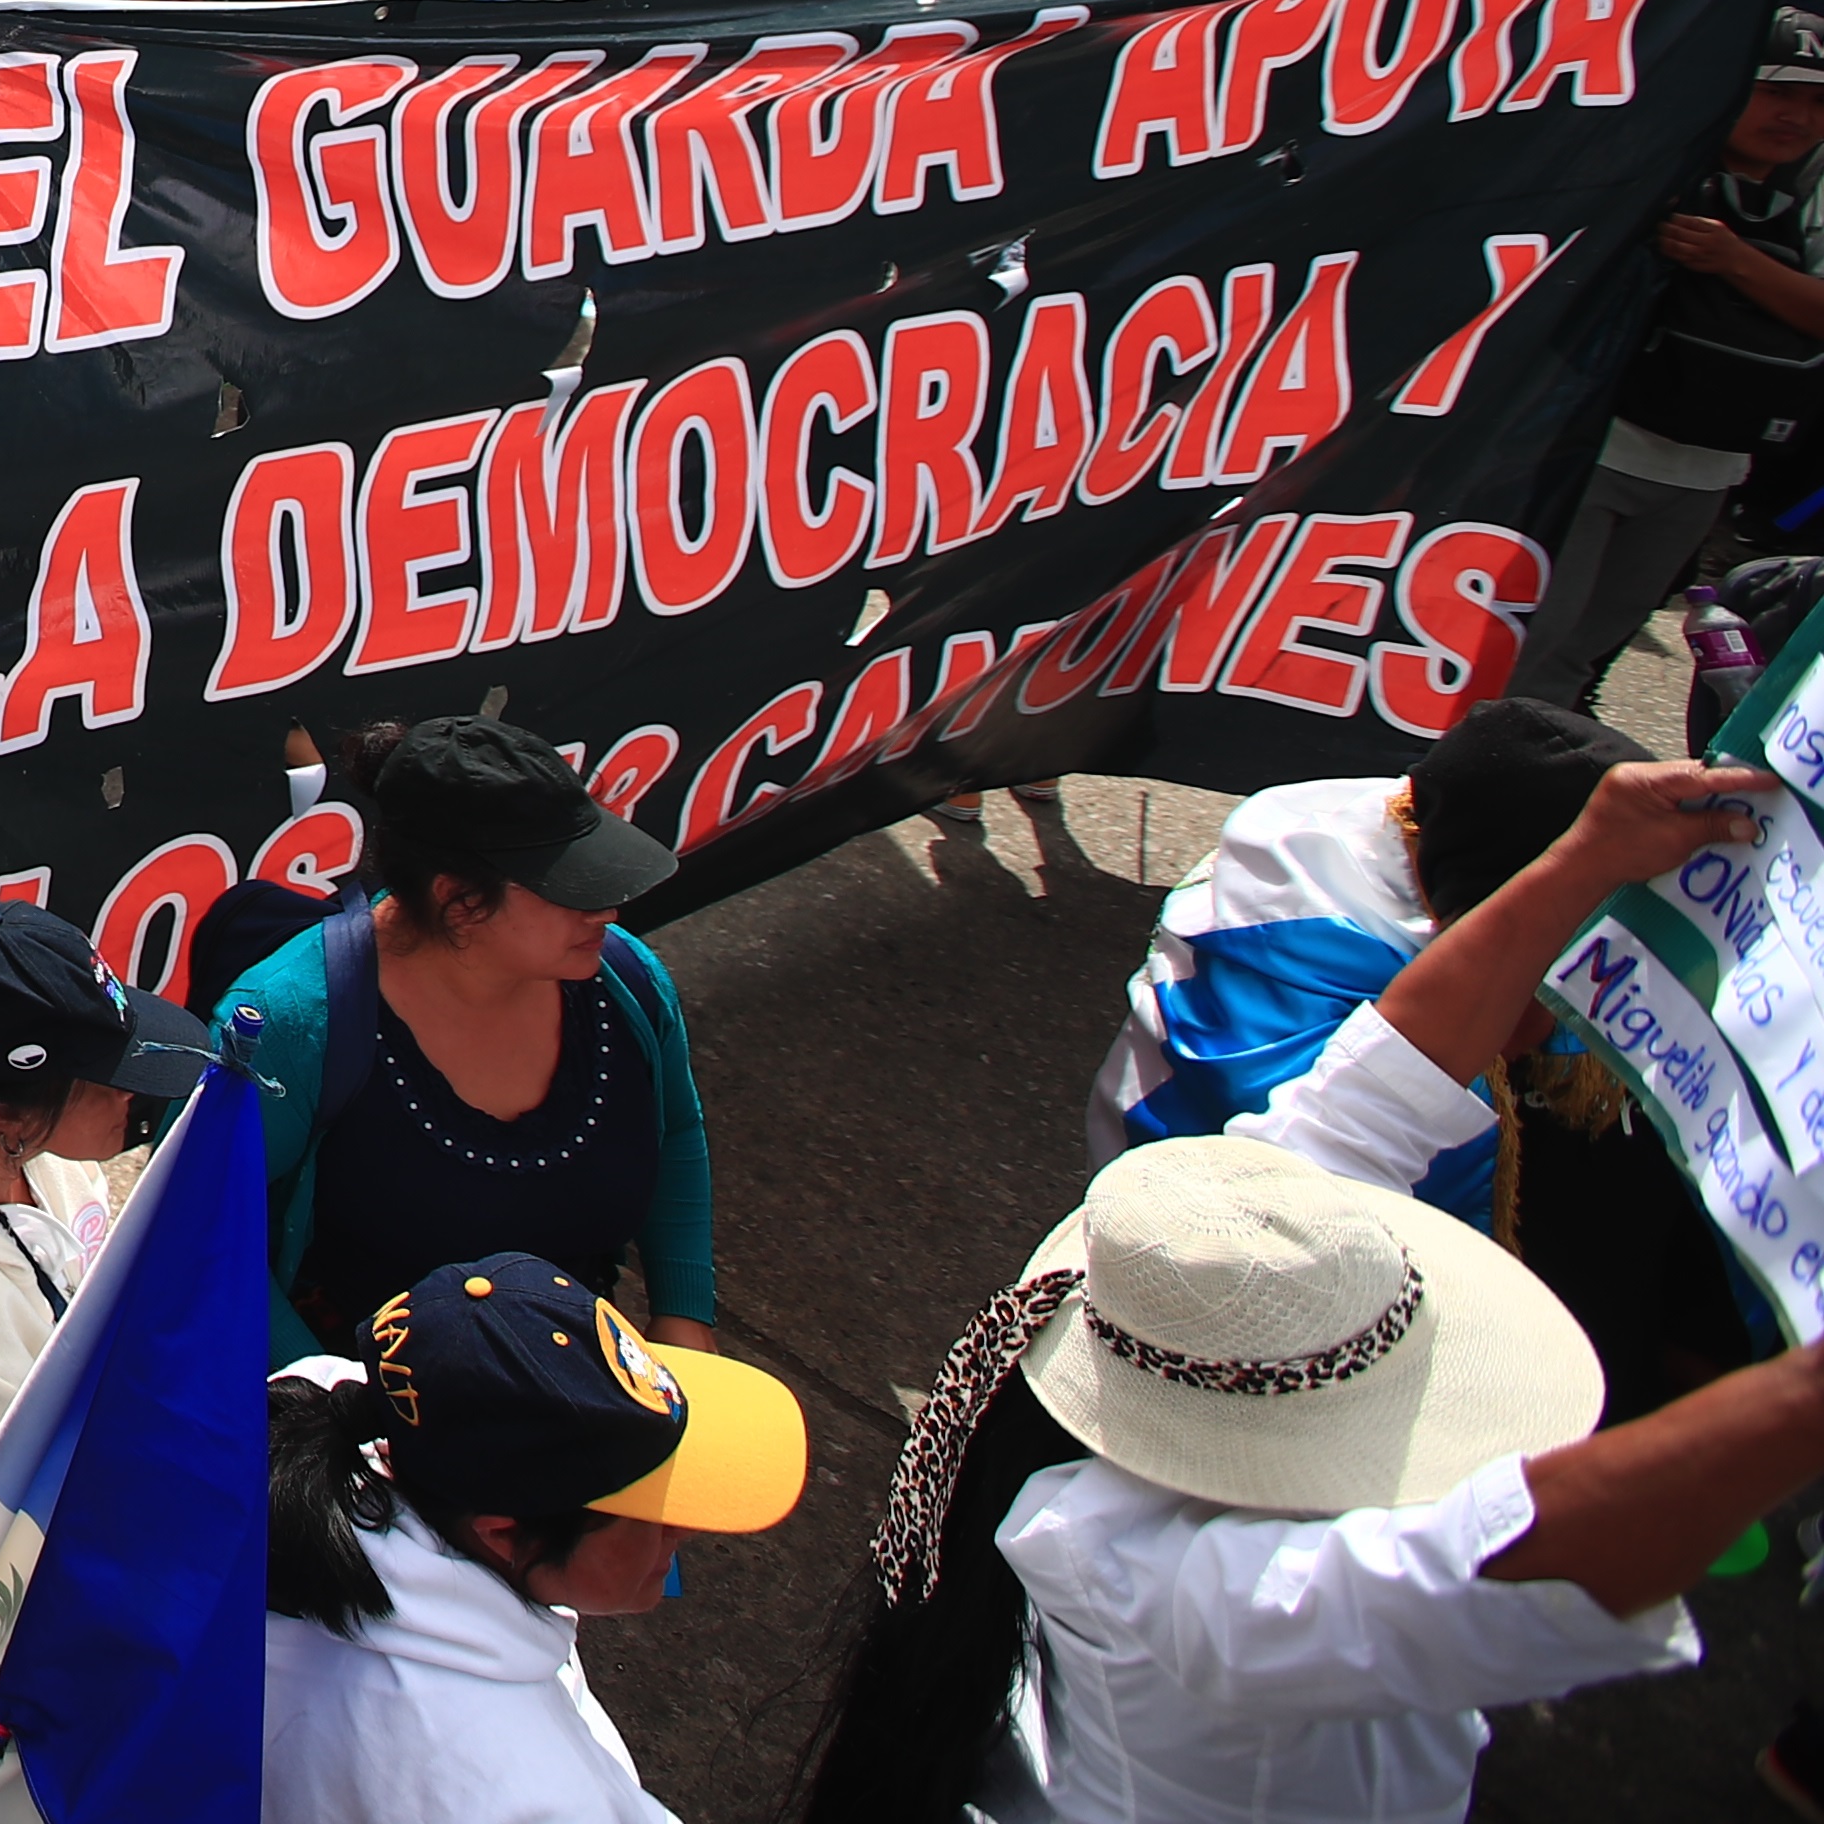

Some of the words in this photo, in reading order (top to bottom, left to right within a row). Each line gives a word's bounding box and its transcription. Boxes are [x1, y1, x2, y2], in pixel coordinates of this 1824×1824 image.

[255, 4, 1092, 320] GUARDA
[206, 249, 1359, 702] DEMOCRACIA
[1392, 231, 1582, 420] Y
[675, 512, 1552, 858] CANONES
